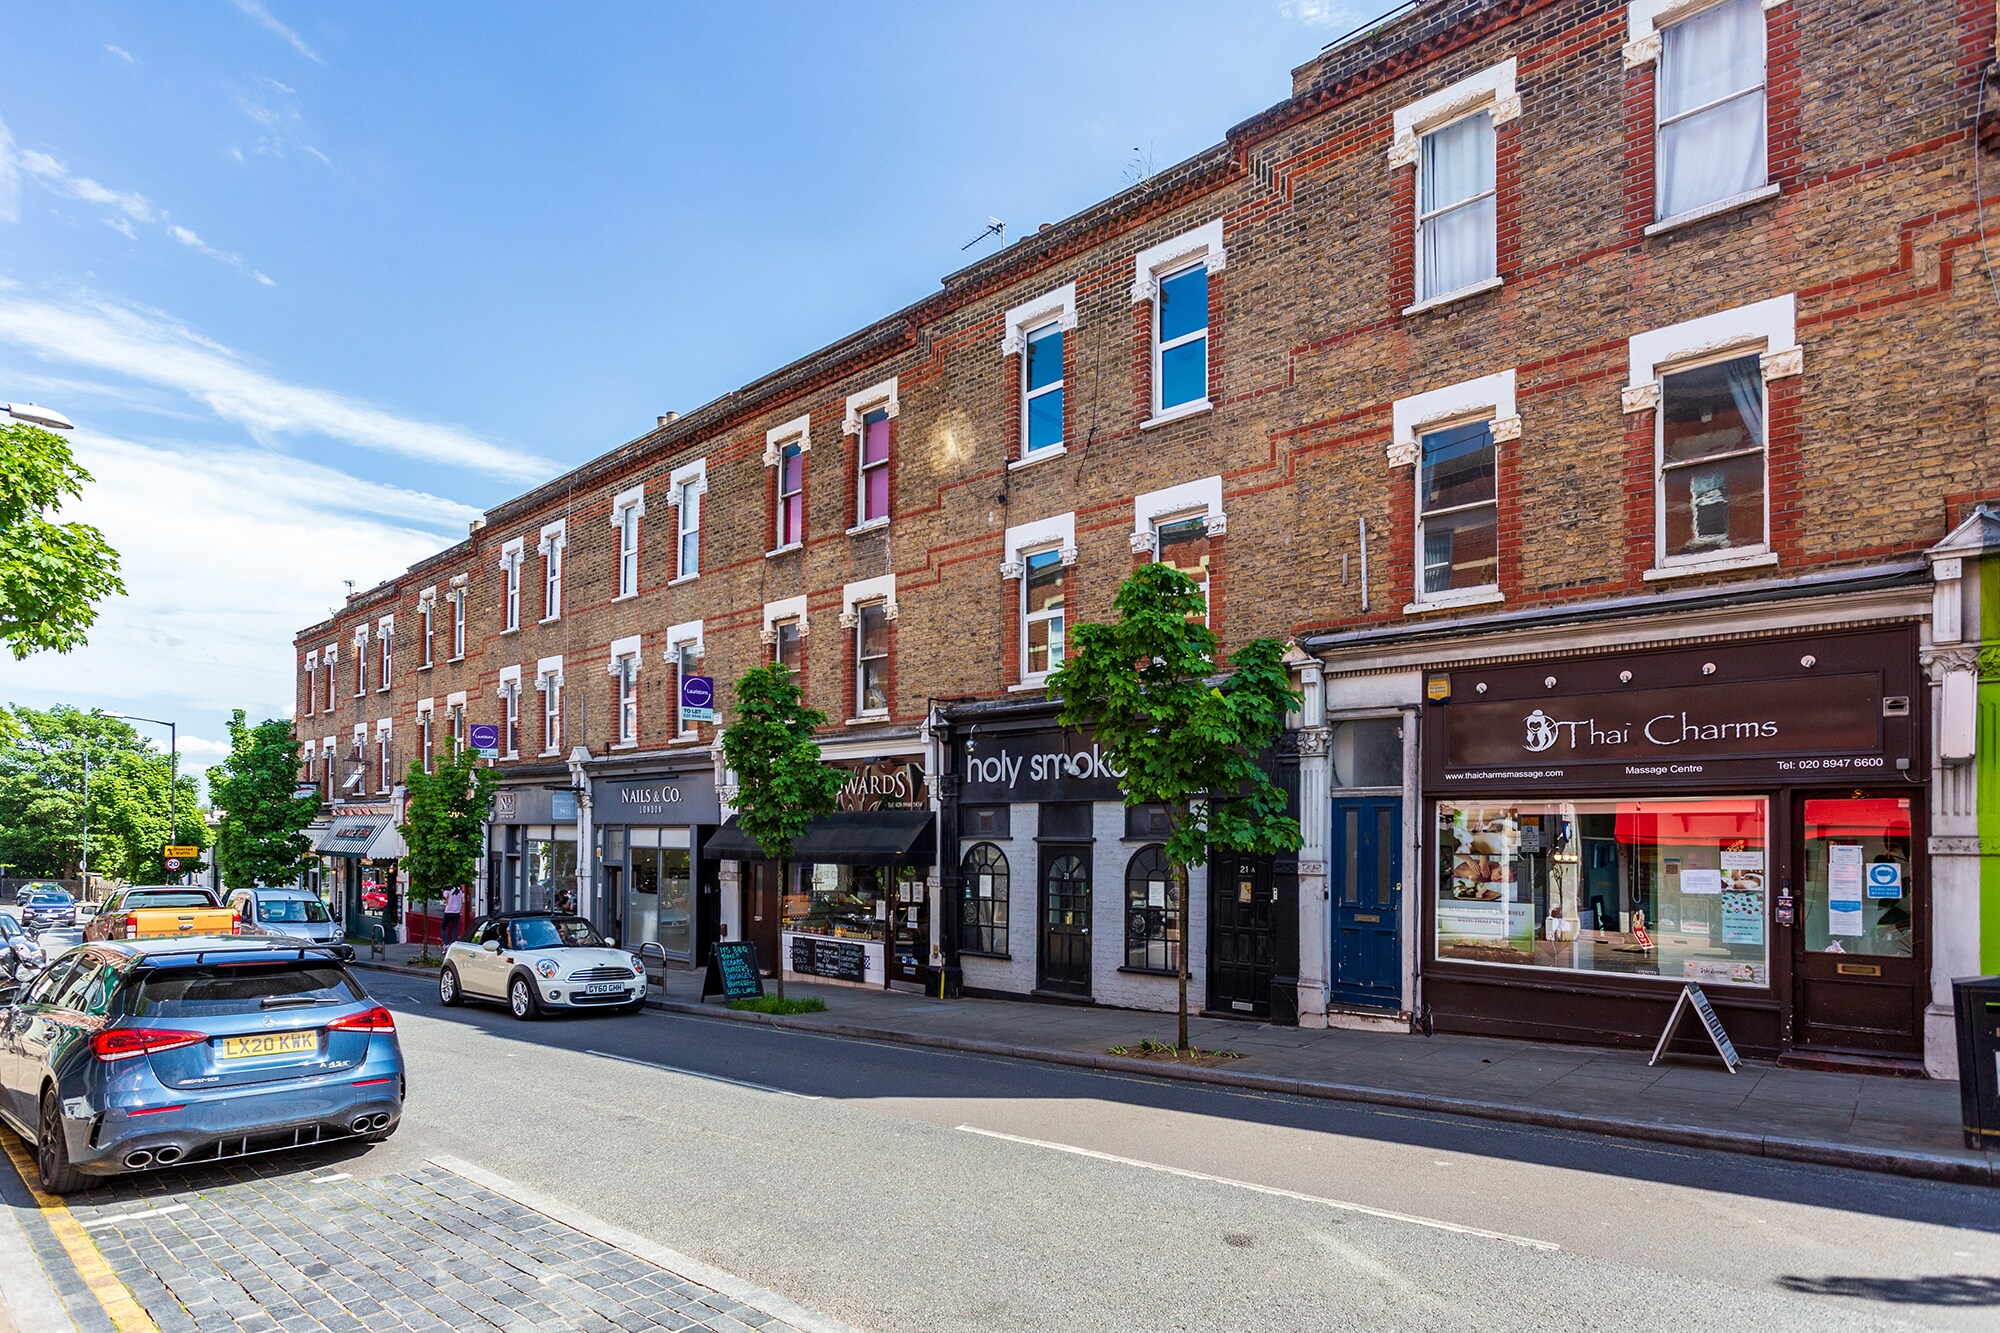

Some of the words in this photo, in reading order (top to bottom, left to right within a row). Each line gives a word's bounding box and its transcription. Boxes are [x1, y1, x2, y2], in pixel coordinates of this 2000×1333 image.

[1556, 719, 1632, 749] Thai
[1644, 711, 1779, 745] Charms
[967, 749, 1023, 789] holy
[1625, 765, 1668, 775] Massage
[1670, 764, 1703, 773] Centre
[1777, 760, 1796, 770] Tel:
[1799, 760, 1820, 769] 020
[1822, 758, 1851, 768] 8947
[1854, 757, 1884, 767] 6600
[1445, 769, 1564, 781] www.thaicharmsmassage.com
[839, 772, 907, 798] WARDS
[621, 788, 651, 804] NAILS
[653, 793, 660, 803] &
[639, 805, 662, 814] LONDON
[1240, 865, 1249, 874] 21
[1063, 872, 1070, 880] 21
[1700, 967, 1728, 976] Welcome
[589, 985, 608, 993] GY60
[608, 984, 622, 992] GHH
[226, 1036, 274, 1056] LX20
[279, 1033, 313, 1050] KWK
